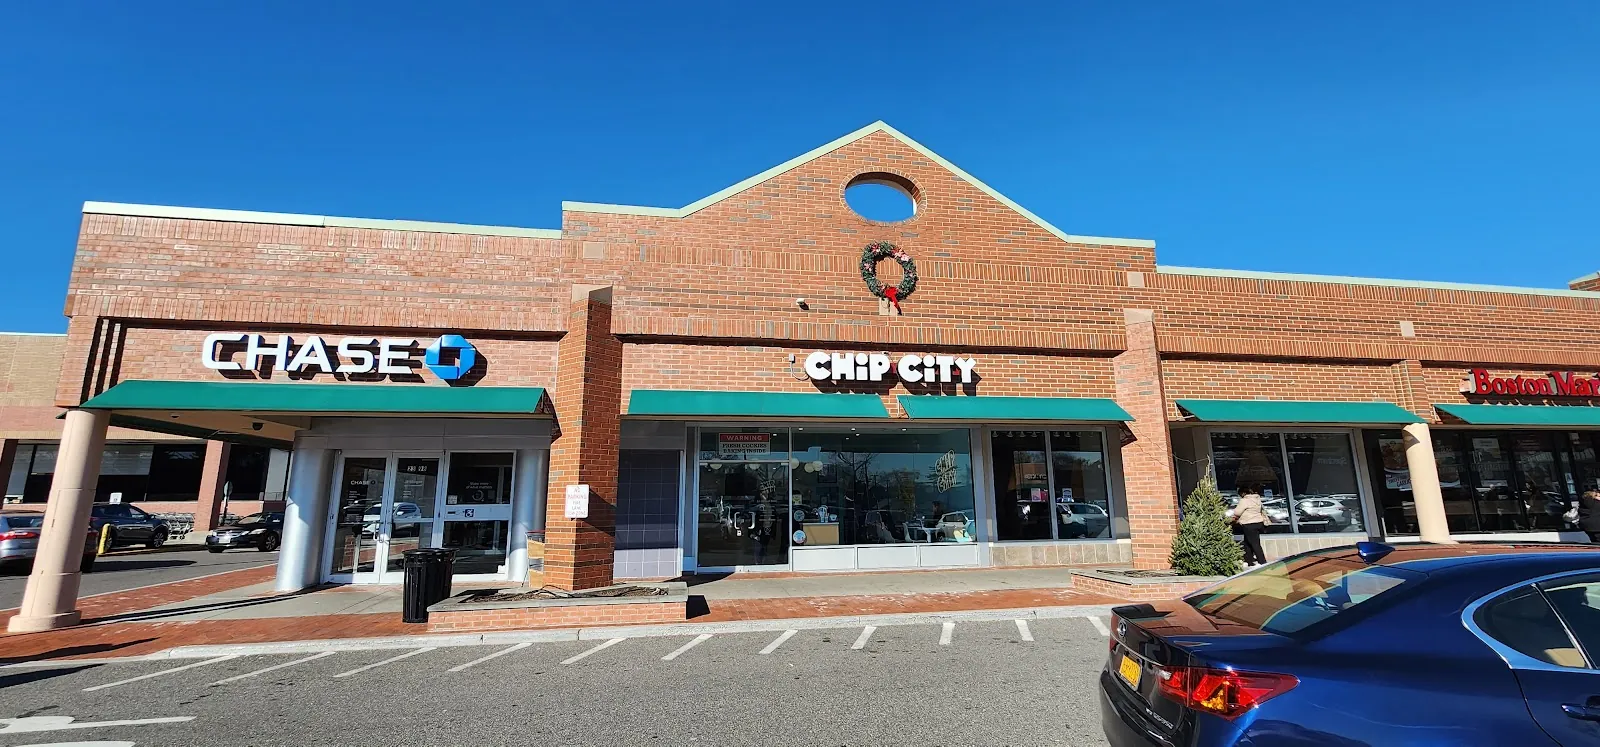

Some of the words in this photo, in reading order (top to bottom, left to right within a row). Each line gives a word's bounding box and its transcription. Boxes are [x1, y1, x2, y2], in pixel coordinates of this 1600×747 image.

[201, 333, 417, 373] CHASE
[1471, 368, 1553, 395] Boston
[1551, 371, 1600, 396] Mar
